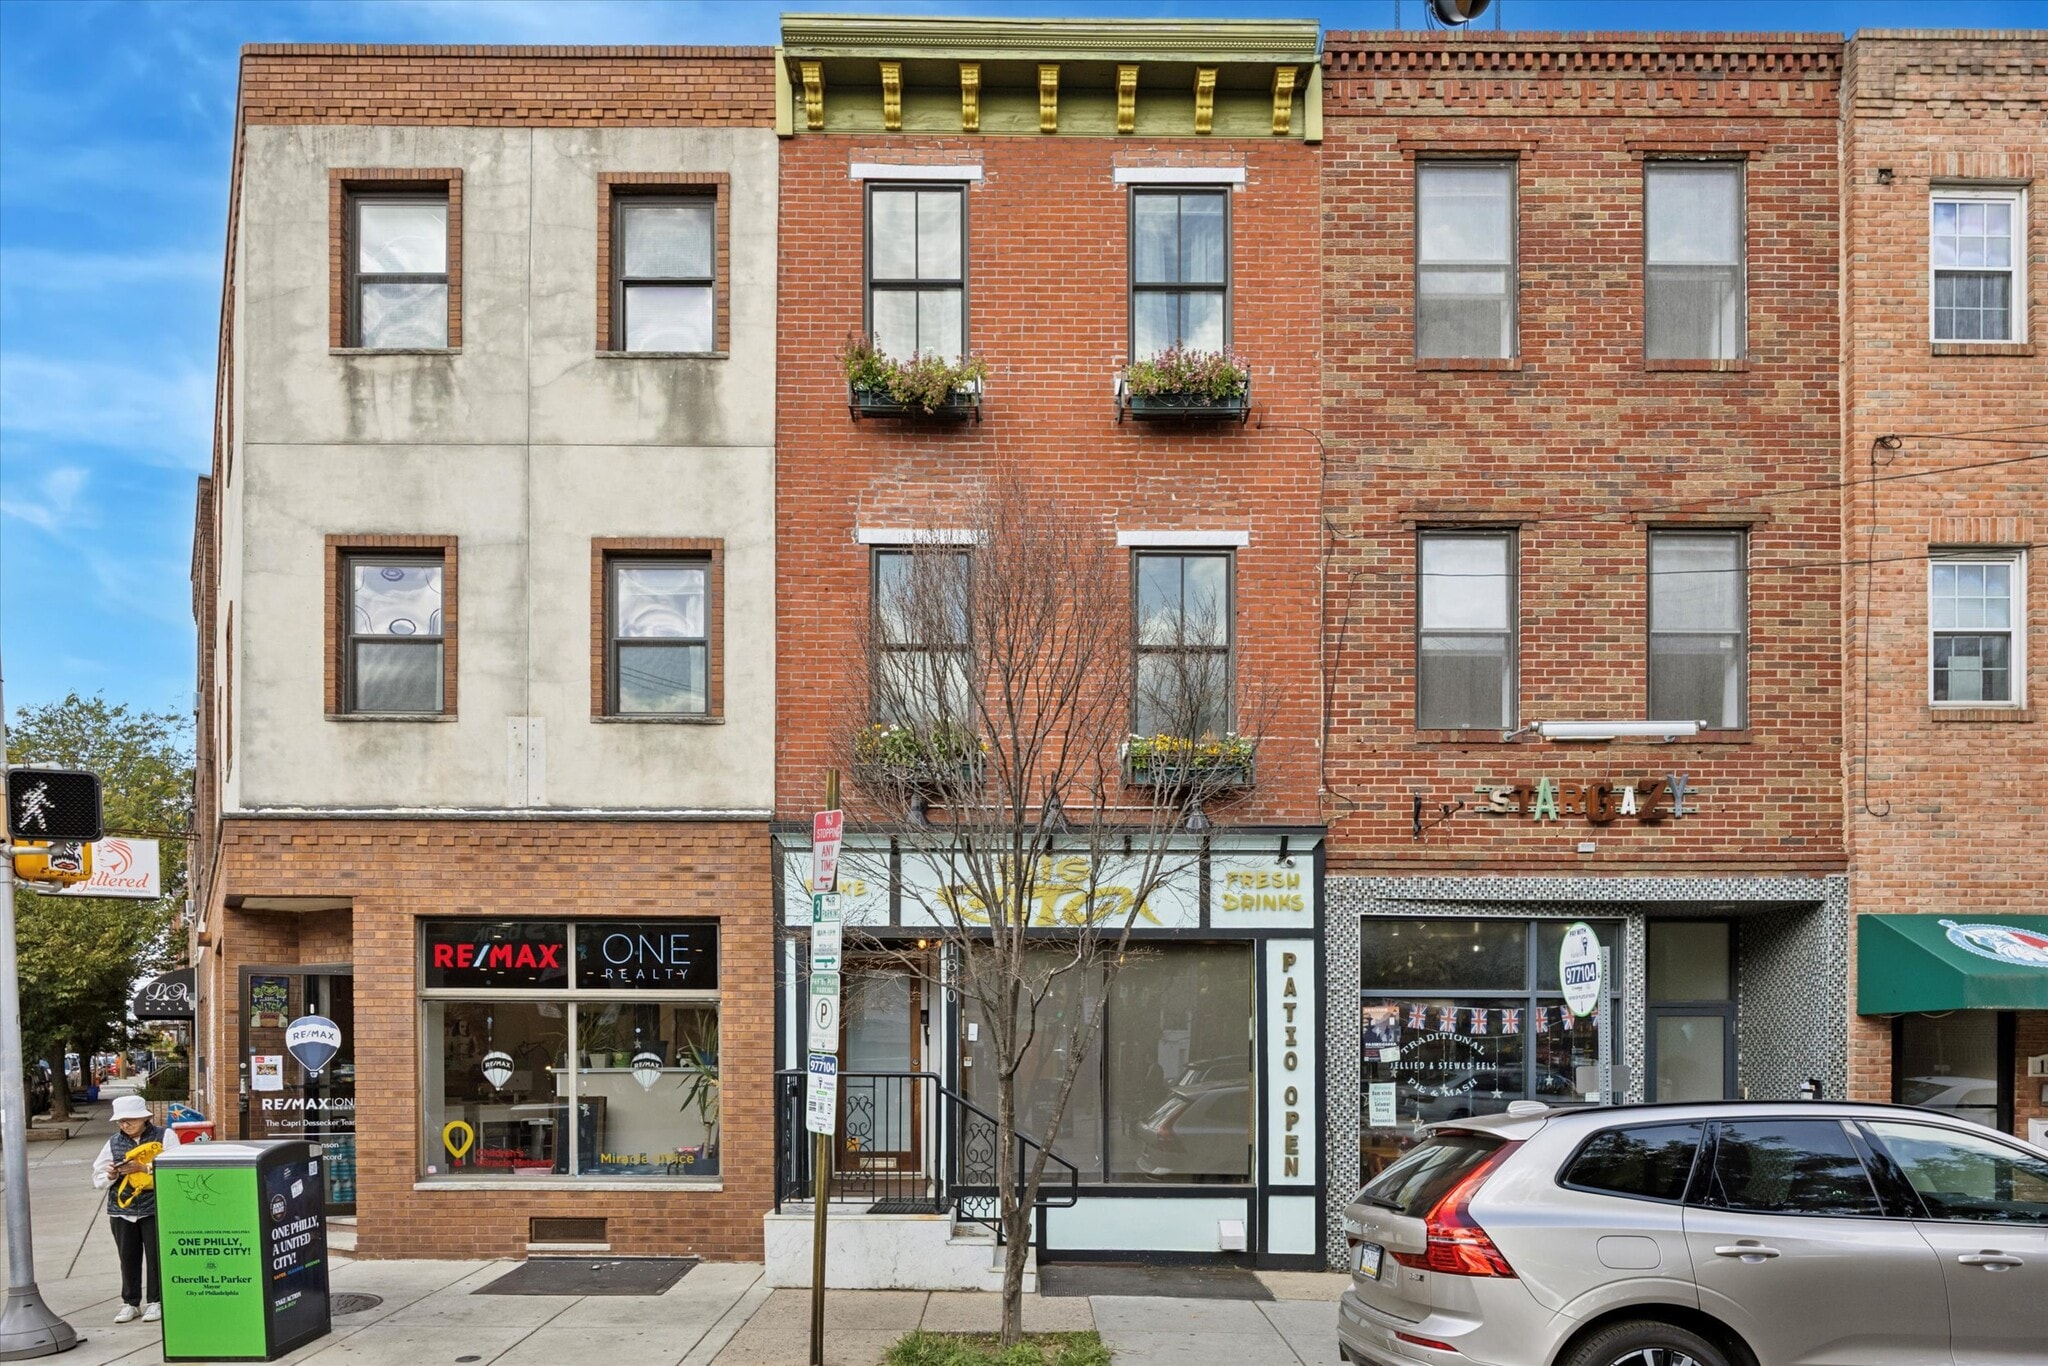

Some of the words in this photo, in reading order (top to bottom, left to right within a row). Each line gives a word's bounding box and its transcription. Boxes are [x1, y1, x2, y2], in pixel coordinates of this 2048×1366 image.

[1488, 773, 1690, 823] STARGAZY
[816, 824, 840, 839] STOPPING
[822, 844, 834, 857] ANY
[821, 859, 833, 872] TIME
[77, 870, 149, 892] filtered
[1226, 871, 1300, 890] FRESH
[815, 900, 821, 920] 3
[1222, 893, 1304, 912] DRINKS
[434, 943, 559, 968] RE/MAX
[603, 933, 690, 964] ONE
[605, 968, 688, 980] REALTY
[1566, 964, 1595, 984] 977104
[820, 1003, 828, 1022] P
[1282, 952, 1298, 1072] PATIO
[292, 1030, 334, 1041] RE/MAX
[1400, 1032, 1486, 1056] TRADITIONAL
[484, 1060, 512, 1068] RE/MAX
[634, 1061, 660, 1069] RE/MAX
[810, 1060, 835, 1074] 977104
[1390, 1061, 1425, 1070] JELLIED
[1429, 1061, 1434, 1070] &
[1438, 1062, 1472, 1070] STEWED
[1476, 1062, 1497, 1070] EELS
[1407, 1077, 1426, 1094] PIE
[1430, 1090, 1439, 1098] &
[1444, 1078, 1478, 1097] MASH
[262, 1098, 329, 1110] RE/MAX
[334, 1098, 354, 1106] ON
[281, 1119, 300, 1128] Capri
[303, 1119, 339, 1127] Dessecker
[1284, 1086, 1300, 1177] OPEN
[600, 1152, 648, 1164] Miracle
[272, 1225, 290, 1240] ONE
[290, 1214, 320, 1234] PHILLY,
[178, 1238, 201, 1246] ONE
[204, 1238, 242, 1247] PHILLY,
[272, 1244, 280, 1256] A
[280, 1232, 311, 1252] UNITED
[273, 1252, 297, 1270] CITY!
